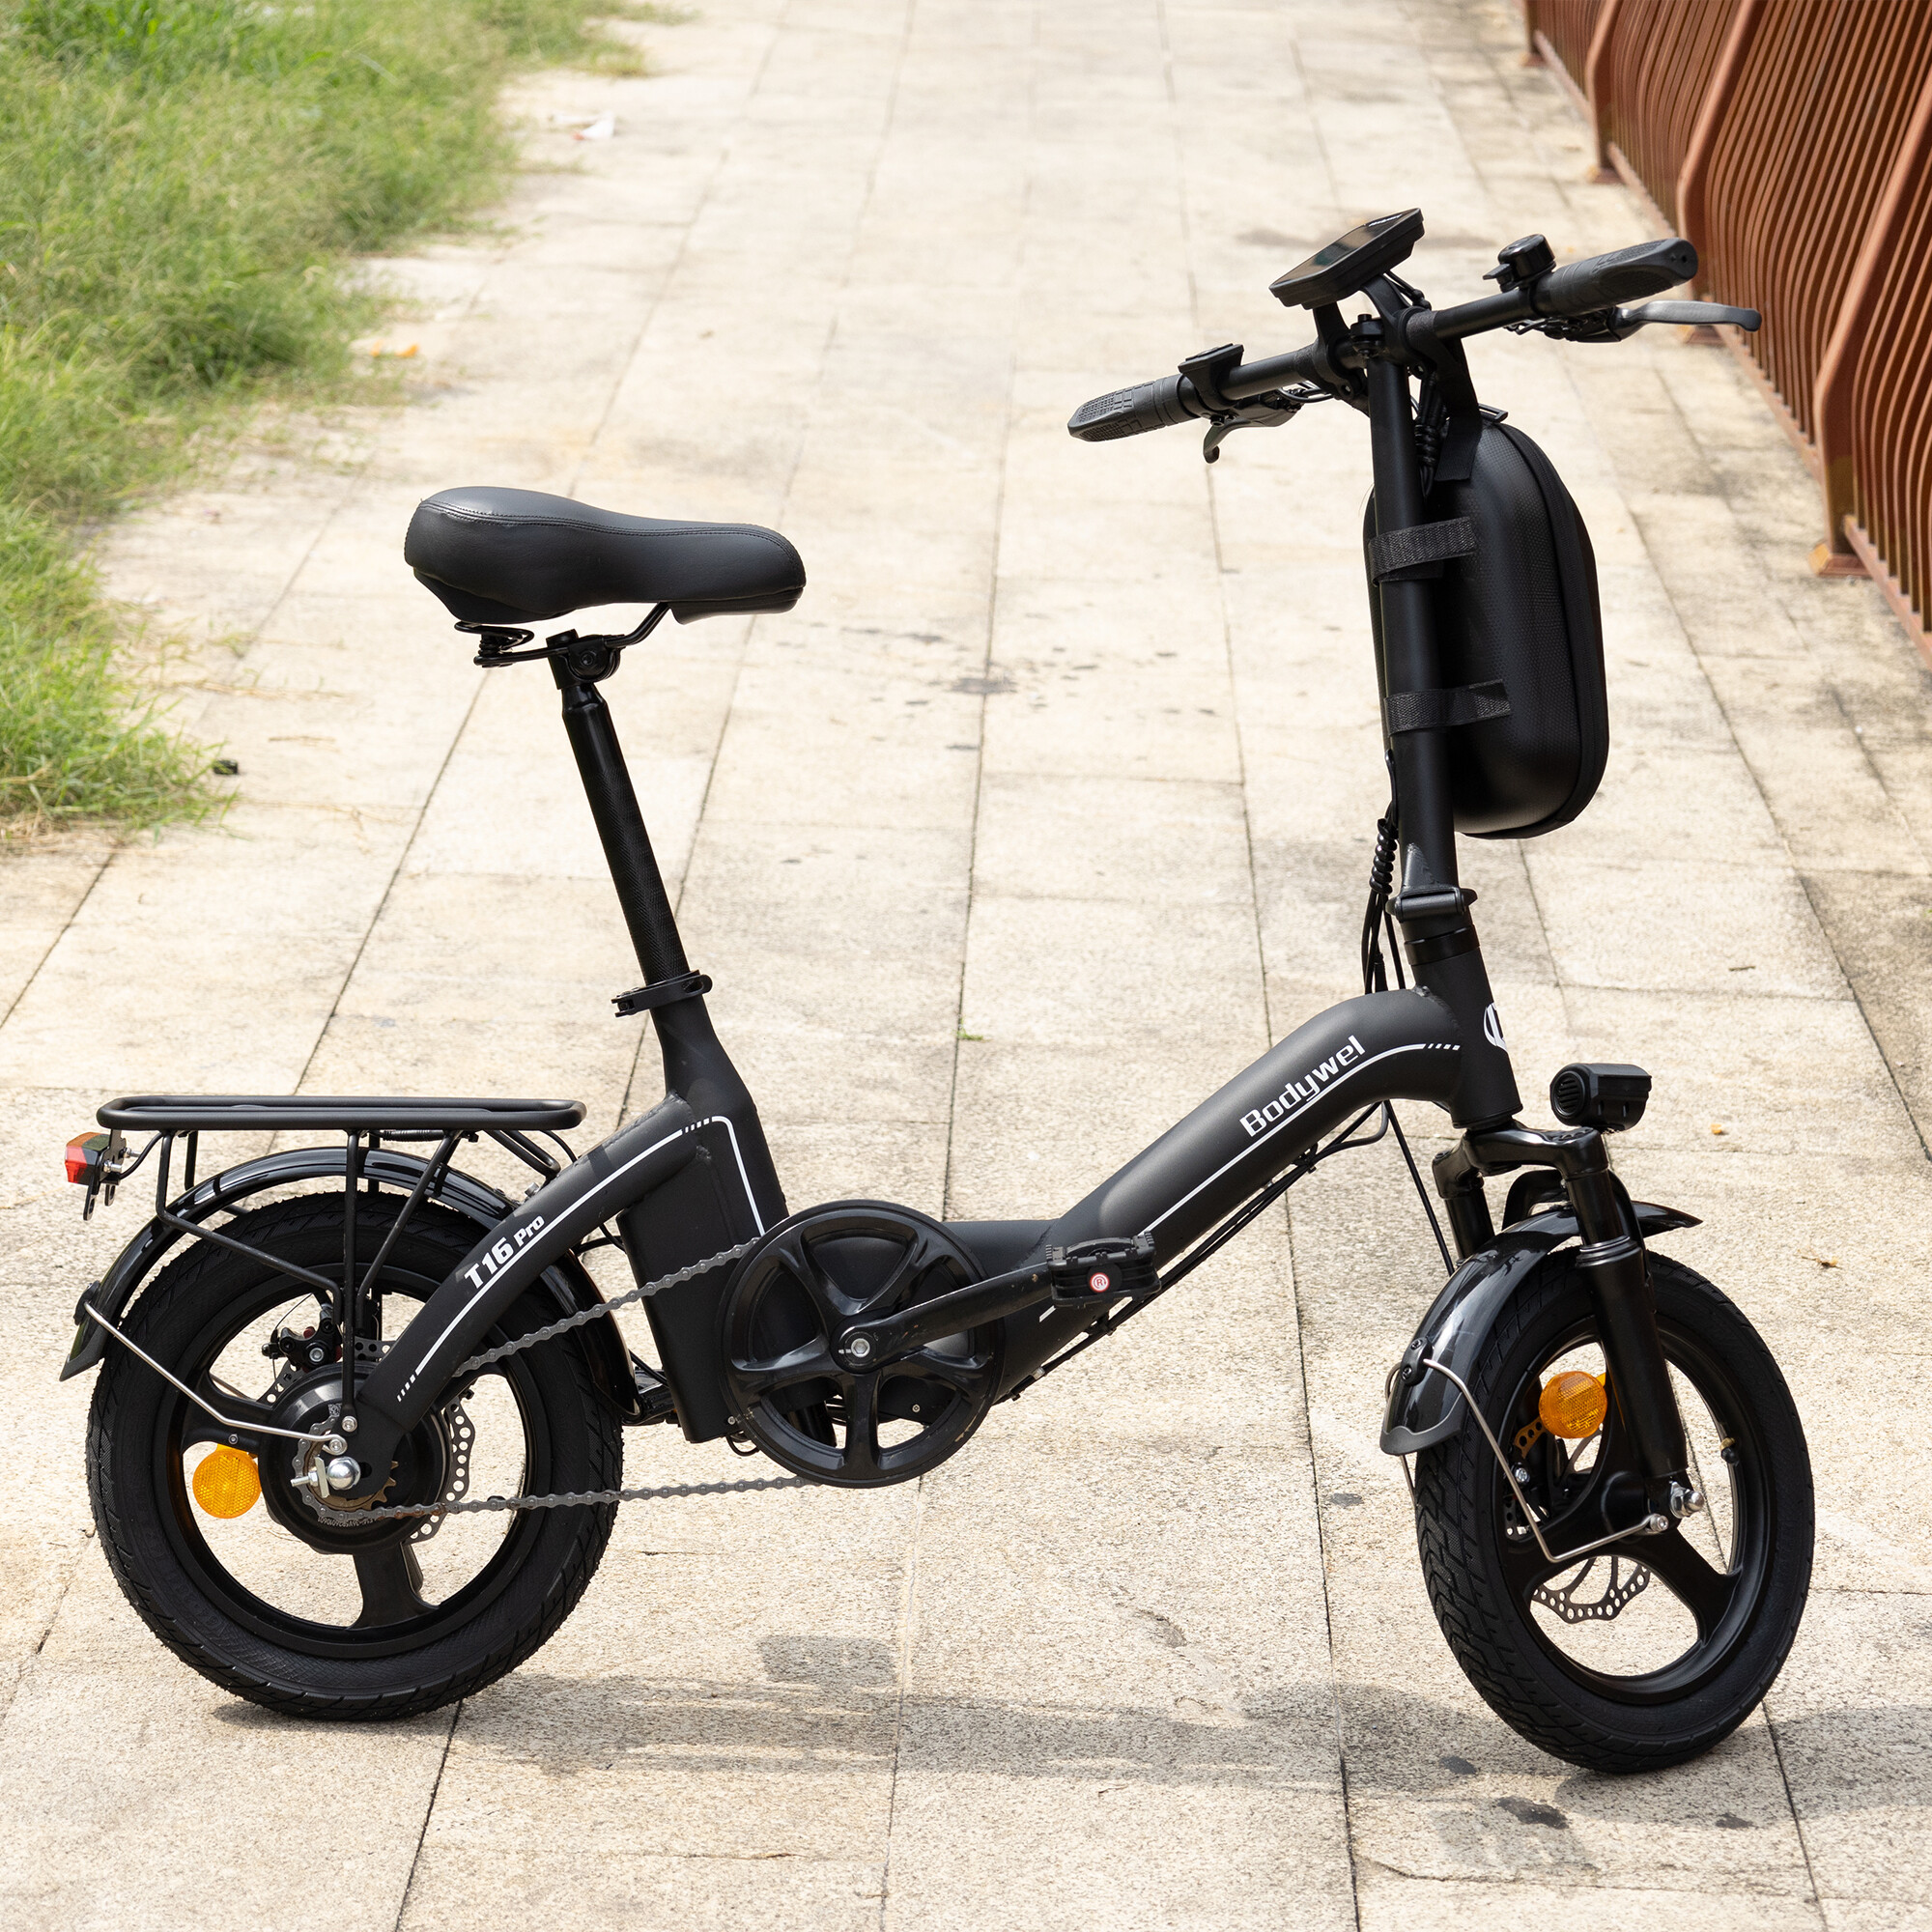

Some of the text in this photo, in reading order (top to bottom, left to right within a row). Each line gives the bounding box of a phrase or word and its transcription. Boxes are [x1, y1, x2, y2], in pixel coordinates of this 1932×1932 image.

[1238, 1035, 1366, 1137] Bodywel
[464, 1215, 545, 1290] T16 Pro
